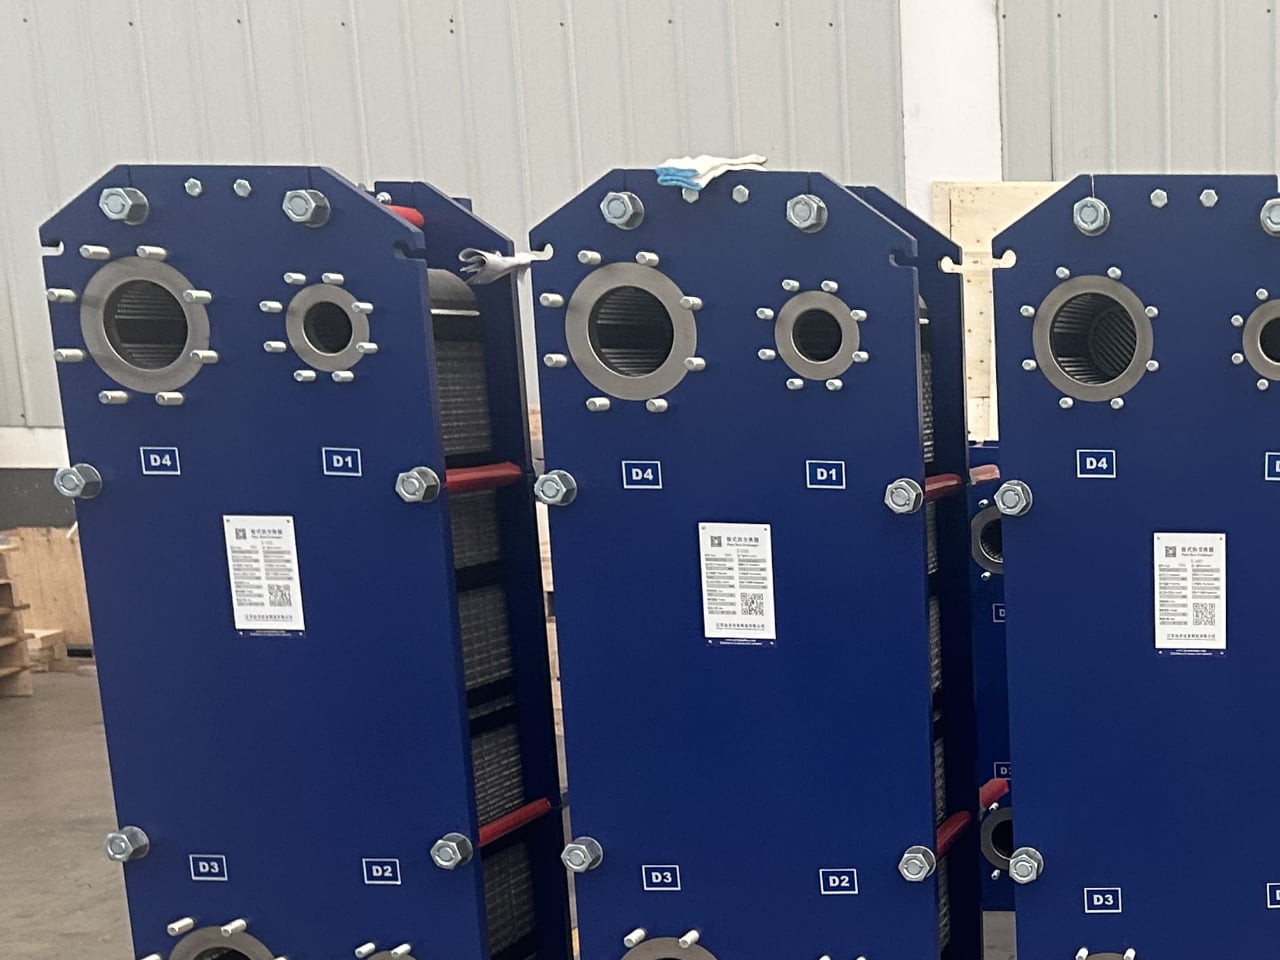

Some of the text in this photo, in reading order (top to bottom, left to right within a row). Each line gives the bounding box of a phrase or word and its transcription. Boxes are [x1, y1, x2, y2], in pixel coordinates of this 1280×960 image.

[150, 454, 172, 466] D4
[333, 455, 353, 467] D1
[1086, 457, 1108, 469] D4
[632, 468, 654, 481] D4
[817, 469, 837, 481] D1
[199, 861, 219, 873] D3
[372, 866, 393, 877] D2
[652, 872, 673, 883] D3
[829, 876, 850, 887] D2
[1094, 894, 1114, 905] D3
